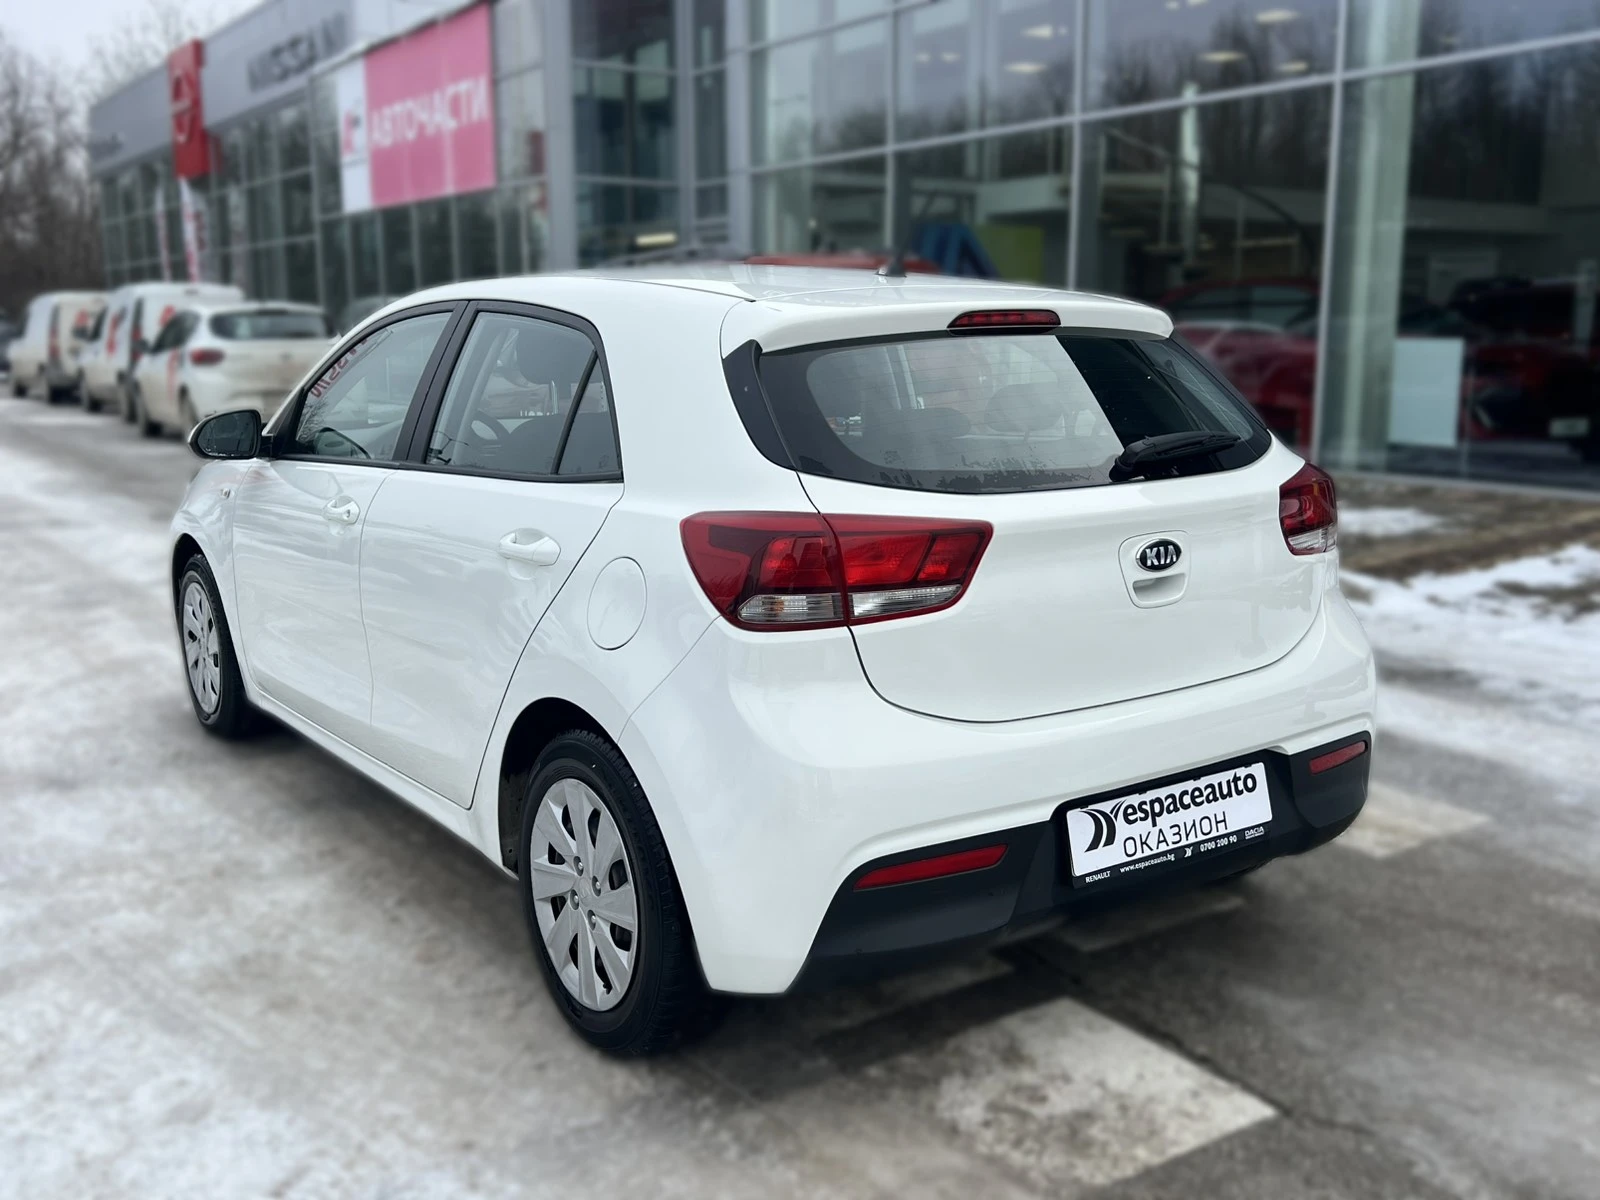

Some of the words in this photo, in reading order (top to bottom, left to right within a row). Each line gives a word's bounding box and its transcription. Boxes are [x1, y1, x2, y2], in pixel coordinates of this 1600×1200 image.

[370, 74, 489, 147] АВТОЧАСТИ
[1145, 544, 1177, 567] KIA
[1123, 772, 1257, 827] espaceauto
[1085, 871, 1111, 883] RENAULT
[1120, 853, 1175, 873] www.espaceauto.bg
[1199, 842, 1215, 852] 0700
[1217, 838, 1228, 848] 200
[1229, 835, 1238, 844] 90
[1245, 827, 1264, 837] DACIA
[1123, 811, 1227, 857] ОКАЗИОН
